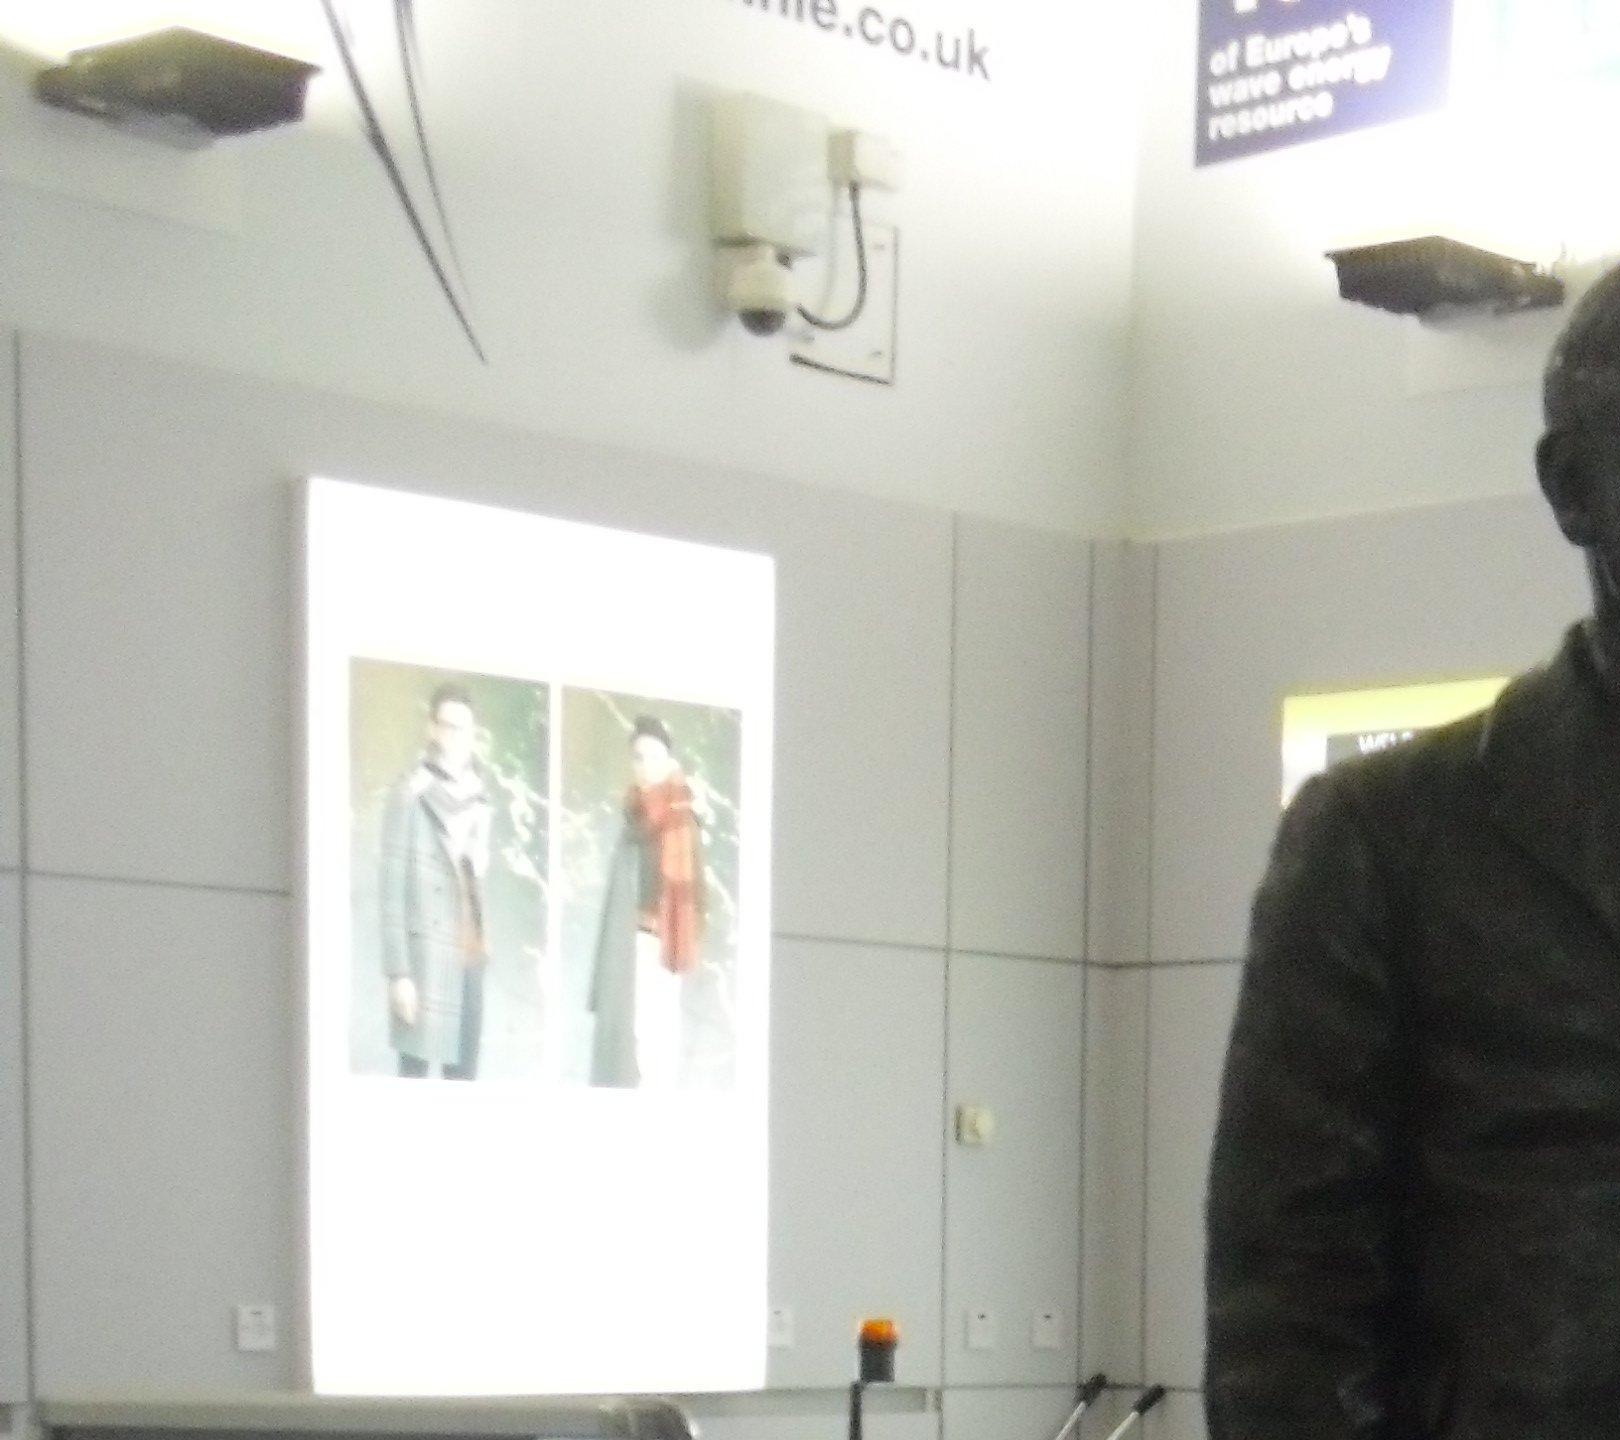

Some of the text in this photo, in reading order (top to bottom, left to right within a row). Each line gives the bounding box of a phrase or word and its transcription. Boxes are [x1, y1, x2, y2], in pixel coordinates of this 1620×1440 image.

[1208, 11, 1374, 77] of Europe's
[1207, 45, 1393, 109] wave energy
[1207, 91, 1334, 141] resource
